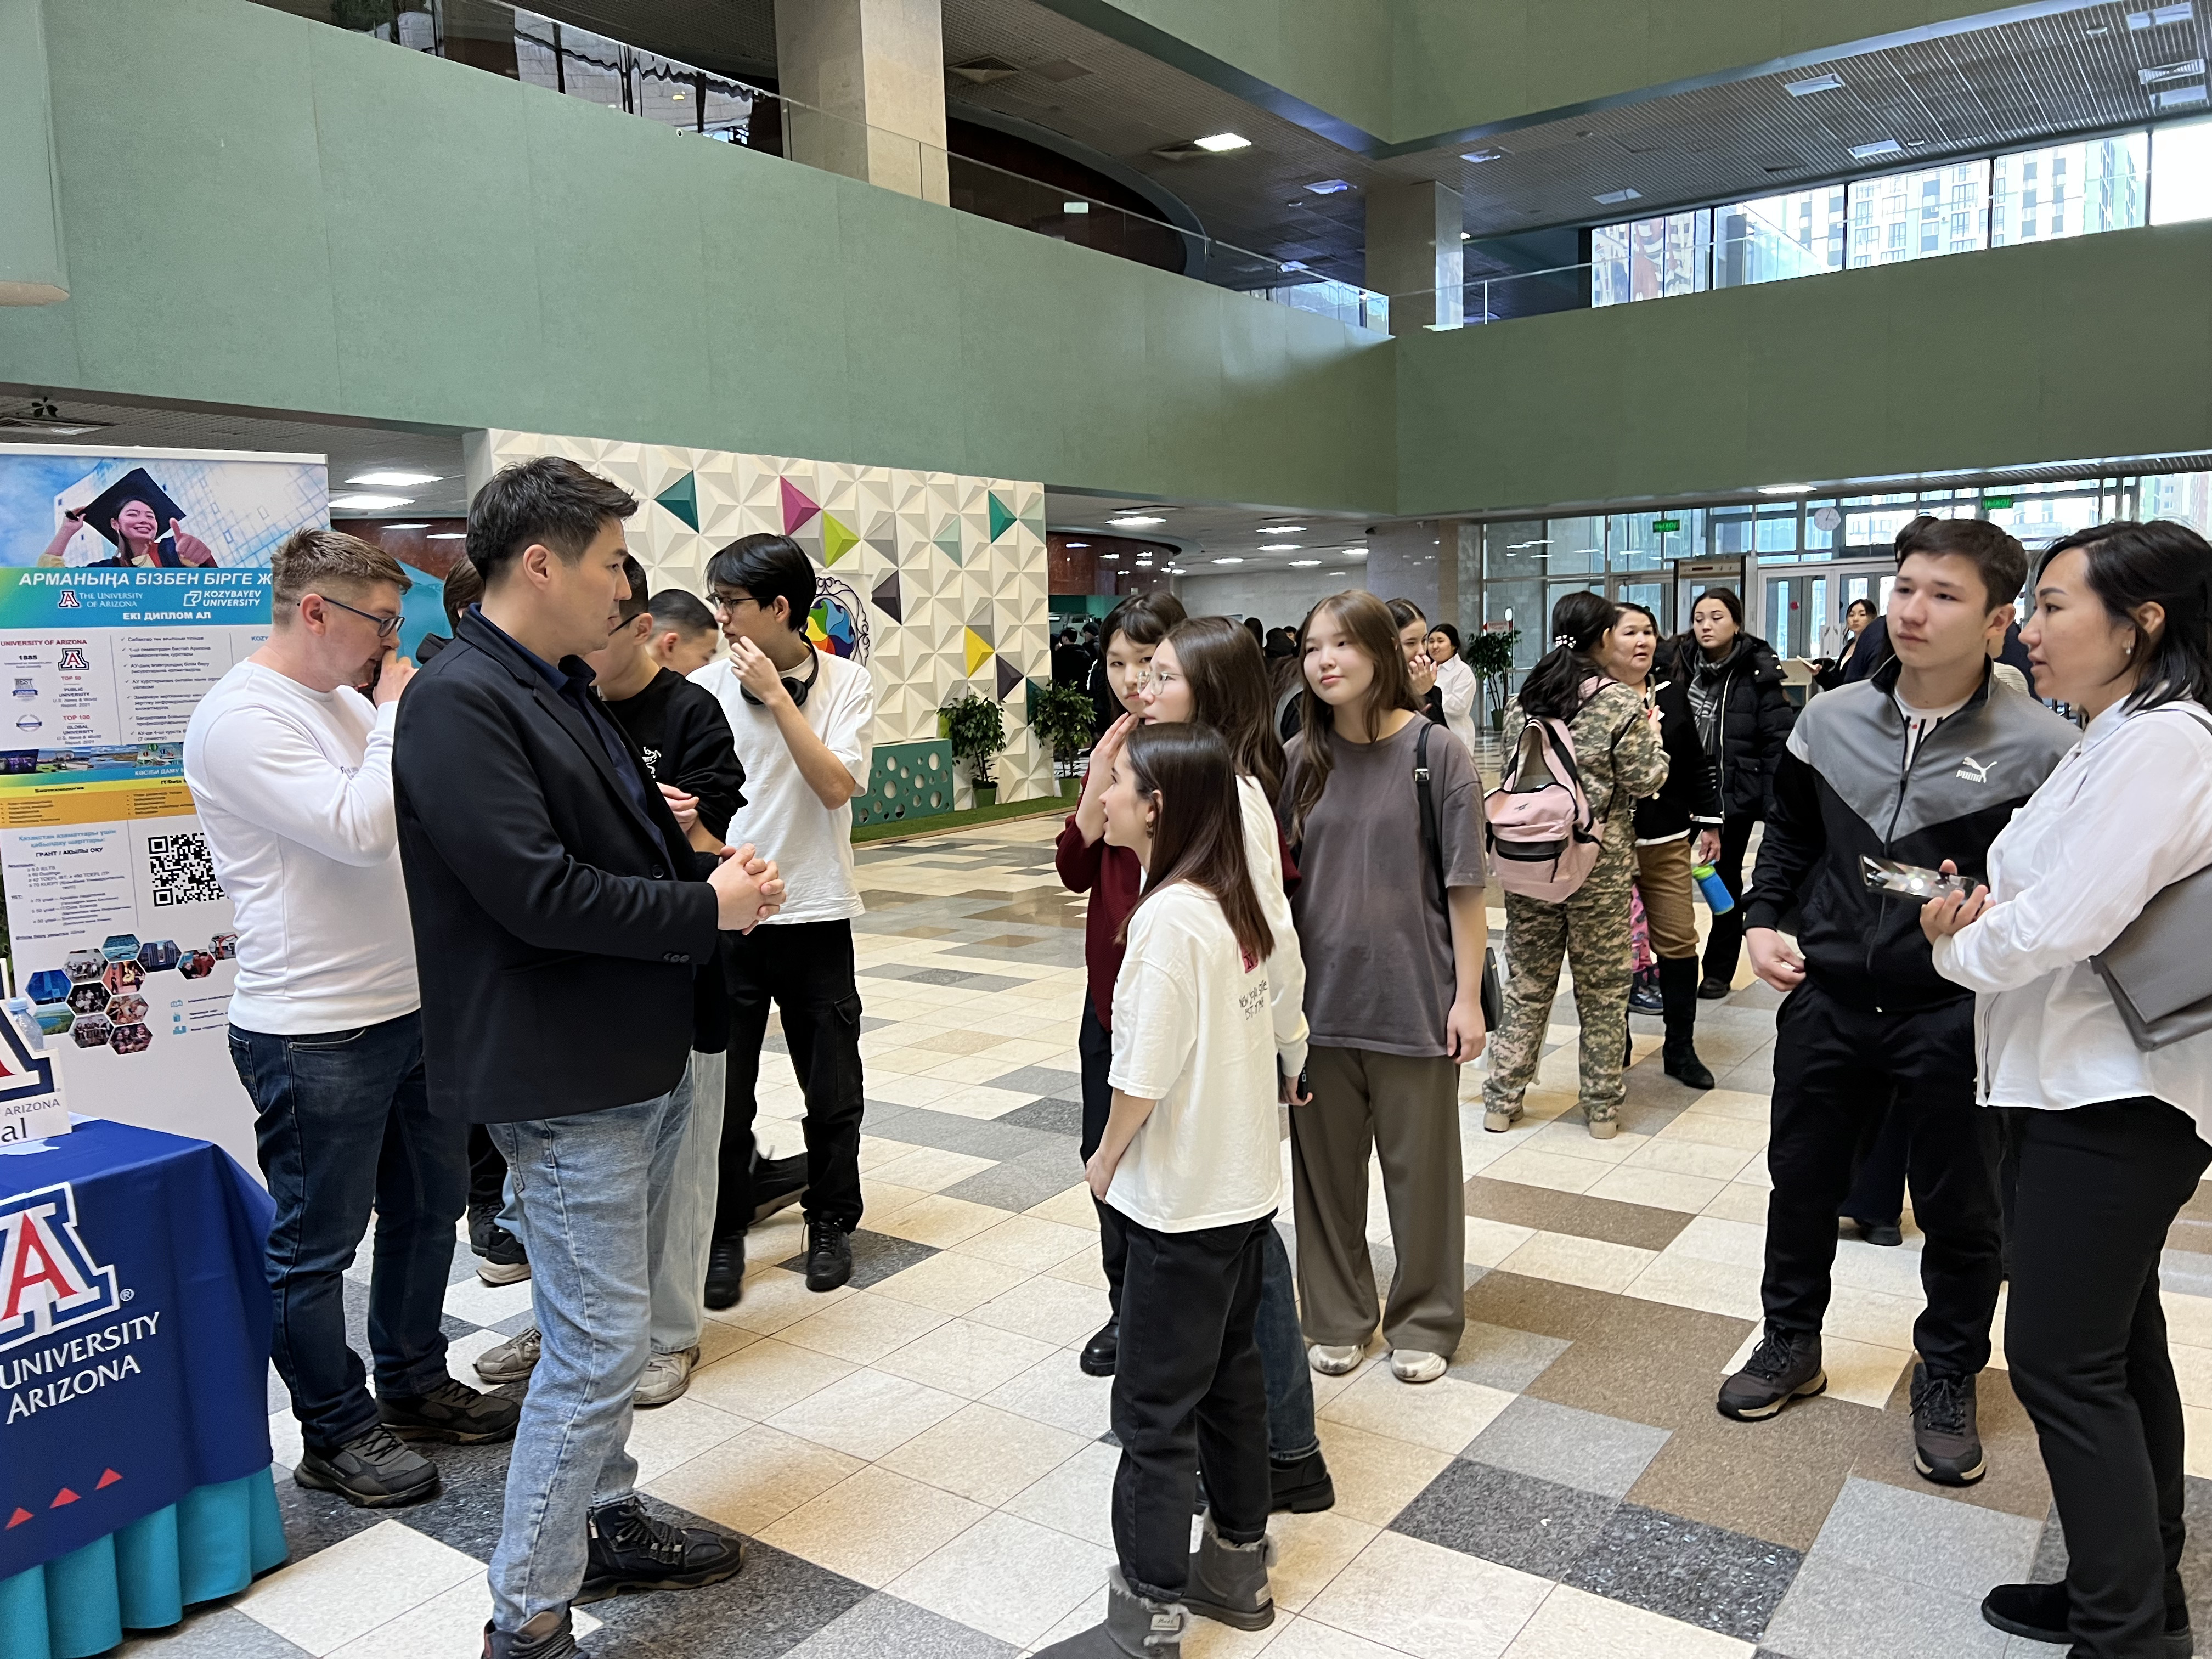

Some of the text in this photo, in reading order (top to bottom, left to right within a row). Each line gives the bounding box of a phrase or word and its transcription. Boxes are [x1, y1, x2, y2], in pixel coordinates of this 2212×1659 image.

[19, 573, 129, 588] АРМАНЫҢА
[136, 573, 199, 585] БІЗБЕН
[204, 573, 253, 585] БІРГЕ
[59, 590, 80, 607] A
[144, 612, 193, 621] ДИПЛОМ
[60, 649, 87, 670] A
[1956, 770, 1983, 783] PUMA
[4, 1098, 61, 1117] ARIZONA
[0, 1312, 160, 1390] UNIVERSITY
[7, 1355, 141, 1425] ARIZONA
